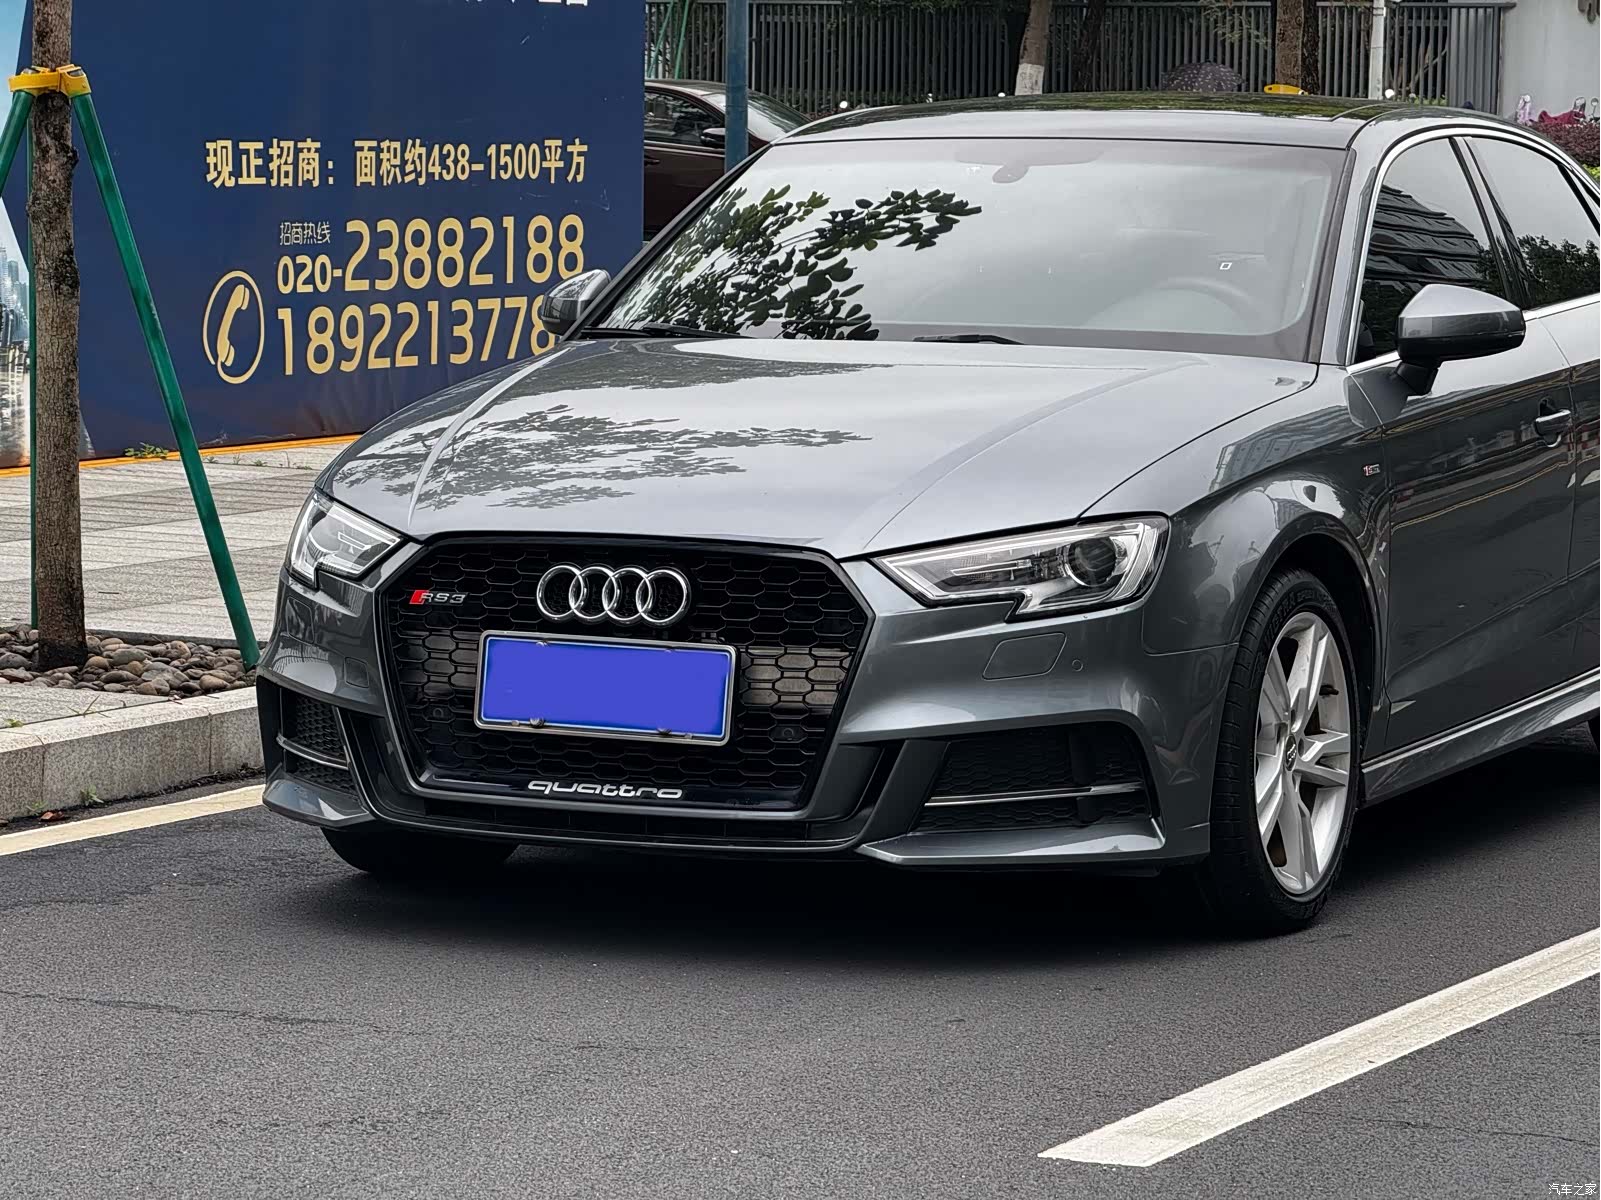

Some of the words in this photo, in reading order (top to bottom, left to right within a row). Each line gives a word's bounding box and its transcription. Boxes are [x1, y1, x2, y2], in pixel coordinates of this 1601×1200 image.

[206, 138, 588, 188] 现正招商：面积约438-1500平方
[280, 221, 331, 246] 招商热线
[277, 214, 584, 294] 020-23882188
[277, 295, 556, 376] 1892213778
[419, 592, 466, 604] RS3
[527, 780, 683, 799] quattro
